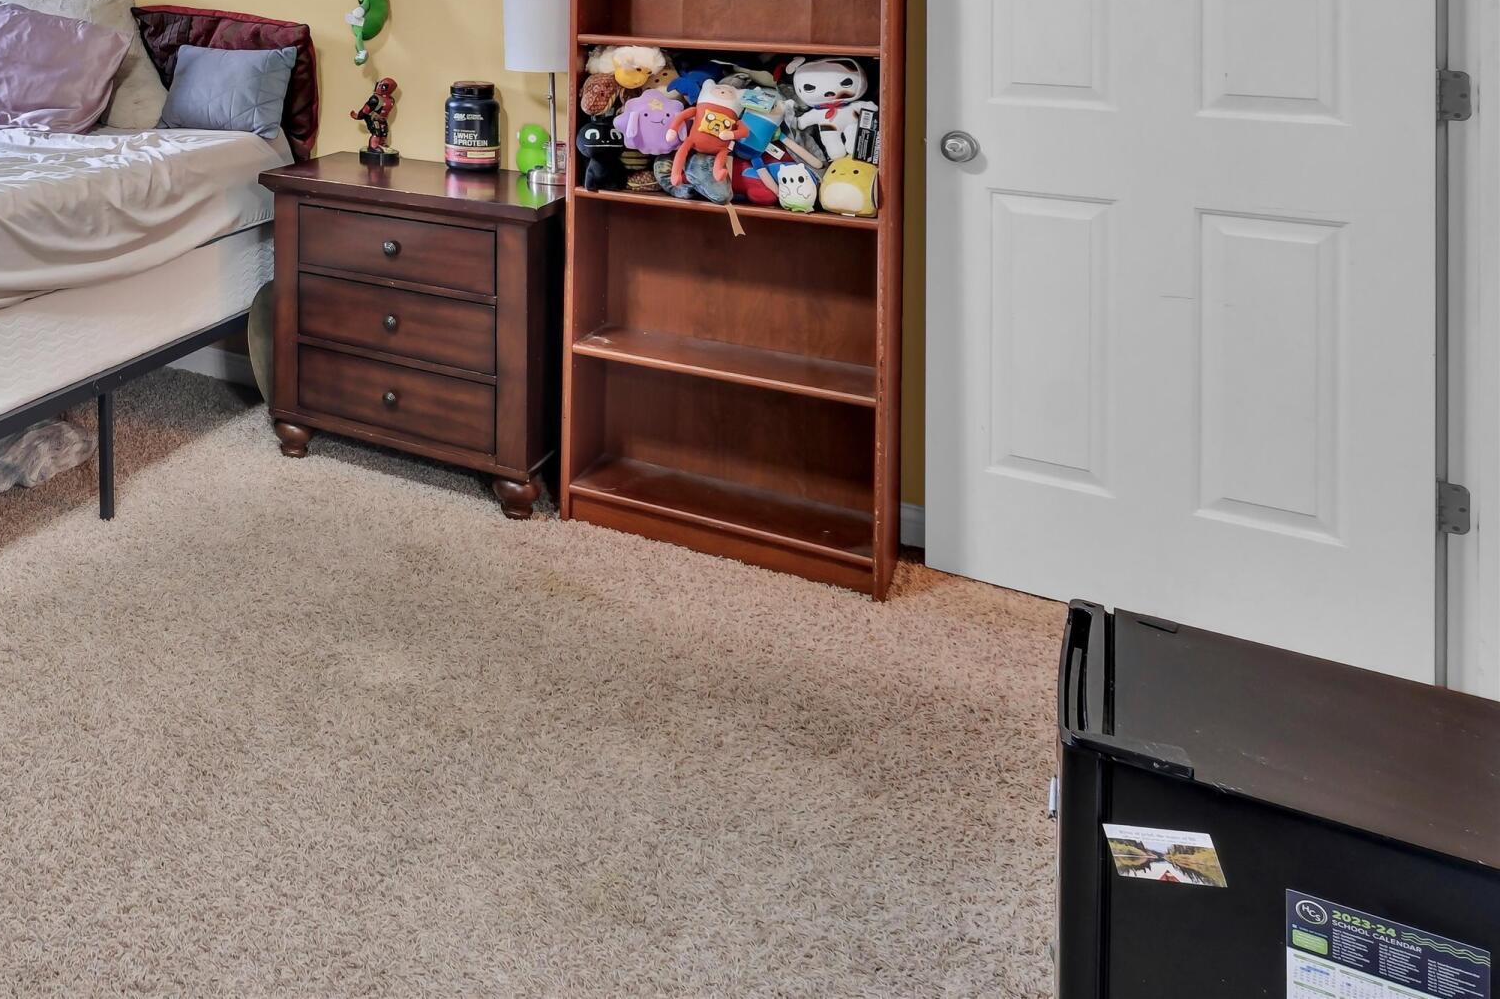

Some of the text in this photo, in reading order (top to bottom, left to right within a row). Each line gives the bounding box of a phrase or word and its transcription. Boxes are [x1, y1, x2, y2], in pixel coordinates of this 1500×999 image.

[457, 132, 478, 140] WHEY
[458, 139, 488, 147] PROTEIN
[1301, 904, 1321, 921] HCS
[1332, 910, 1397, 938] 2023-24
[1332, 919, 1370, 937] SCHOOL
[1372, 932, 1422, 954] CALENDAR
